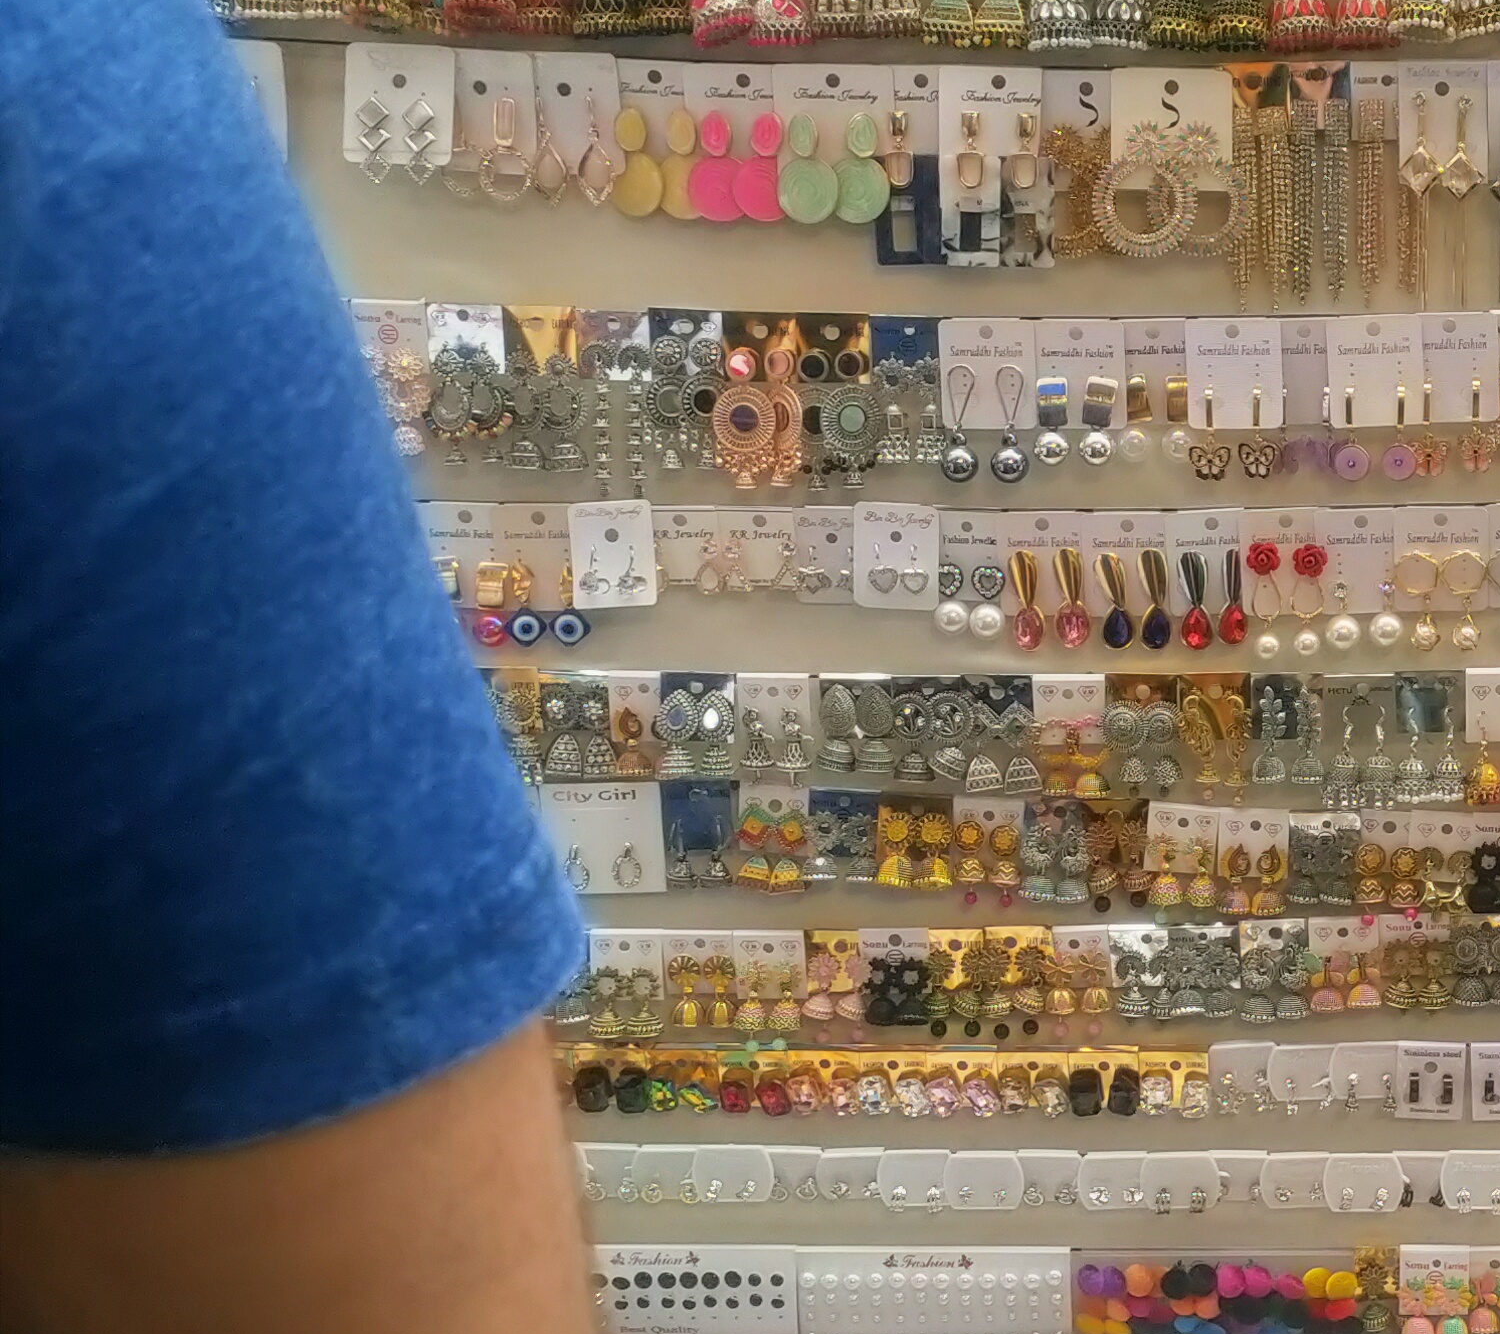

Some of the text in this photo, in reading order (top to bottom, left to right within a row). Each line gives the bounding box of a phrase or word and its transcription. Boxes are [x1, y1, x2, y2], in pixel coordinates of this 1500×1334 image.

[794, 88, 879, 105] Fashion Jewelry
[961, 89, 1003, 104] Fashion
[1197, 344, 1271, 358] Samruddhi Fashion
[1337, 343, 1411, 357] Samruddhi Fashion
[1458, 338, 1487, 351] Fashion
[950, 345, 1024, 358] Samruddhi Fashion
[1040, 346, 1114, 359] Samruddhi Fashion
[674, 530, 714, 543] Jewelry
[752, 529, 791, 543] Jewelry
[1007, 536, 1080, 549] Samruddhi Fashion
[1327, 534, 1367, 547] Samruddhi
[1407, 531, 1479, 544] Samruddhi Fashion
[1092, 537, 1164, 549] Samruddhi Fashion
[1175, 537, 1217, 549] Samruddhi
[552, 788, 637, 805] City Girl
[862, 939, 889, 951] Sonu
[1404, 1048, 1463, 1059] Stainless steel
[627, 1251, 684, 1268] Fashion
[900, 1253, 957, 1271] Fashion
[1404, 1259, 1431, 1271] Sonu
